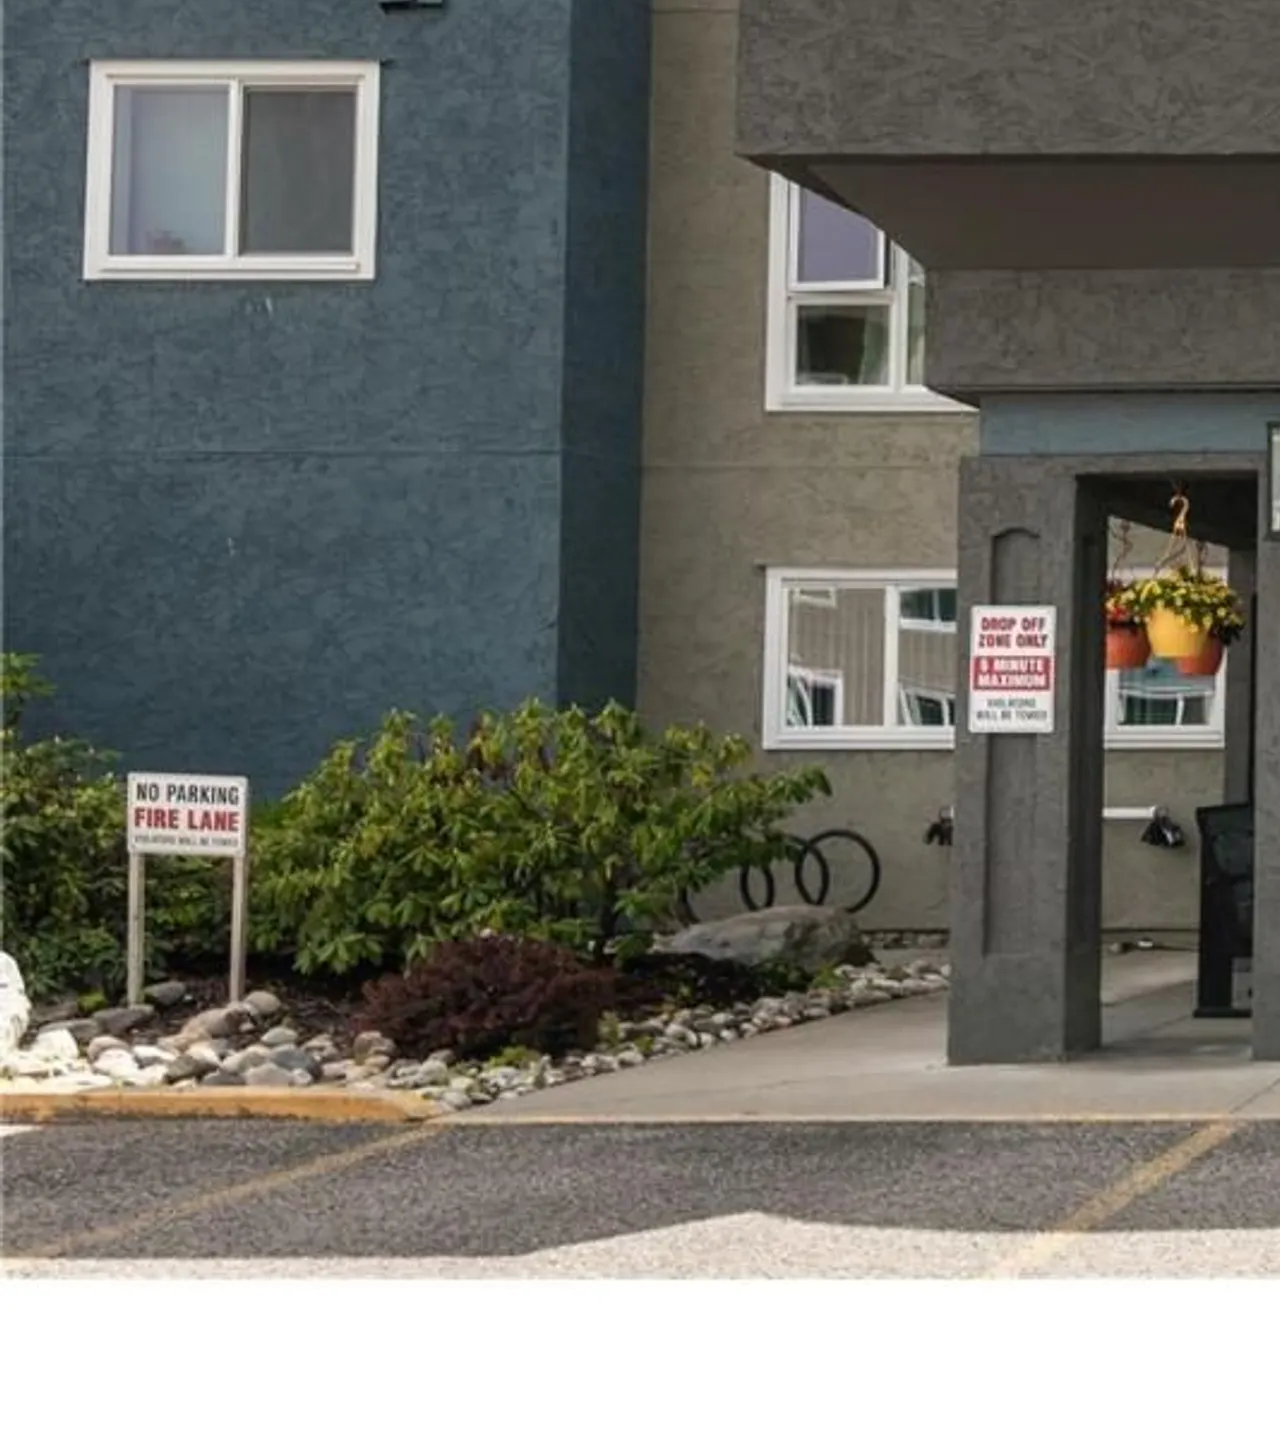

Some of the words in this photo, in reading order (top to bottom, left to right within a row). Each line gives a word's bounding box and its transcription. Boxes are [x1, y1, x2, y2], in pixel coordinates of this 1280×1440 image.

[980, 617, 1017, 631] DROP
[1021, 616, 1046, 631] OFF
[978, 634, 1012, 648] ZONE
[1016, 633, 1049, 648] ONLY
[136, 782, 160, 802] NO
[166, 783, 240, 806] PARKING
[134, 807, 180, 830] FIRE
[187, 809, 240, 832] LANE
